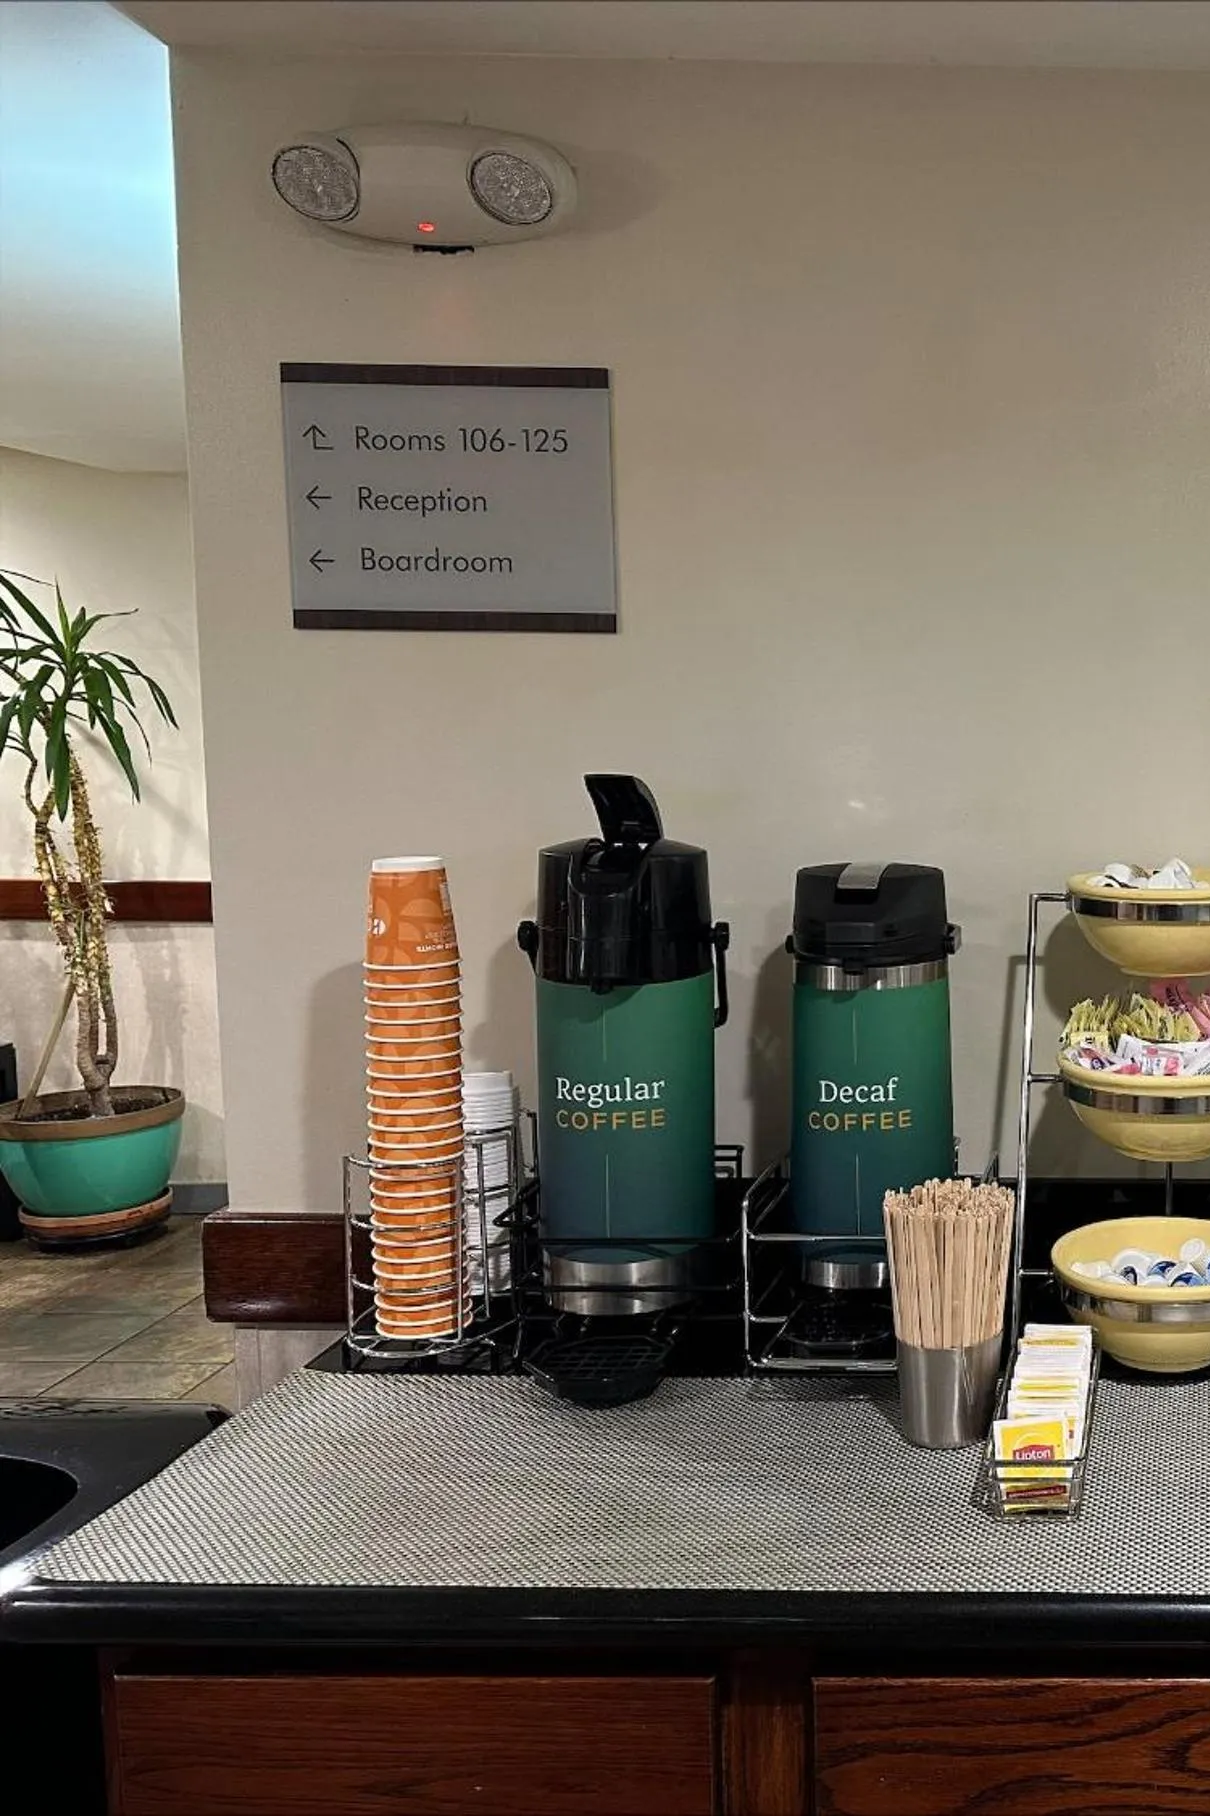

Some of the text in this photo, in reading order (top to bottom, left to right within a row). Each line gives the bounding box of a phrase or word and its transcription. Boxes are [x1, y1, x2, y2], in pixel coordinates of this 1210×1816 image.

[354, 426, 569, 453] Rooms 106-125
[358, 486, 488, 517] Reception
[361, 547, 513, 573] Boardroom
[555, 1077, 665, 1107] Regular
[818, 1076, 900, 1103] Decaf
[555, 1108, 667, 1131] COFFEE
[808, 1109, 913, 1132] COFFEE
